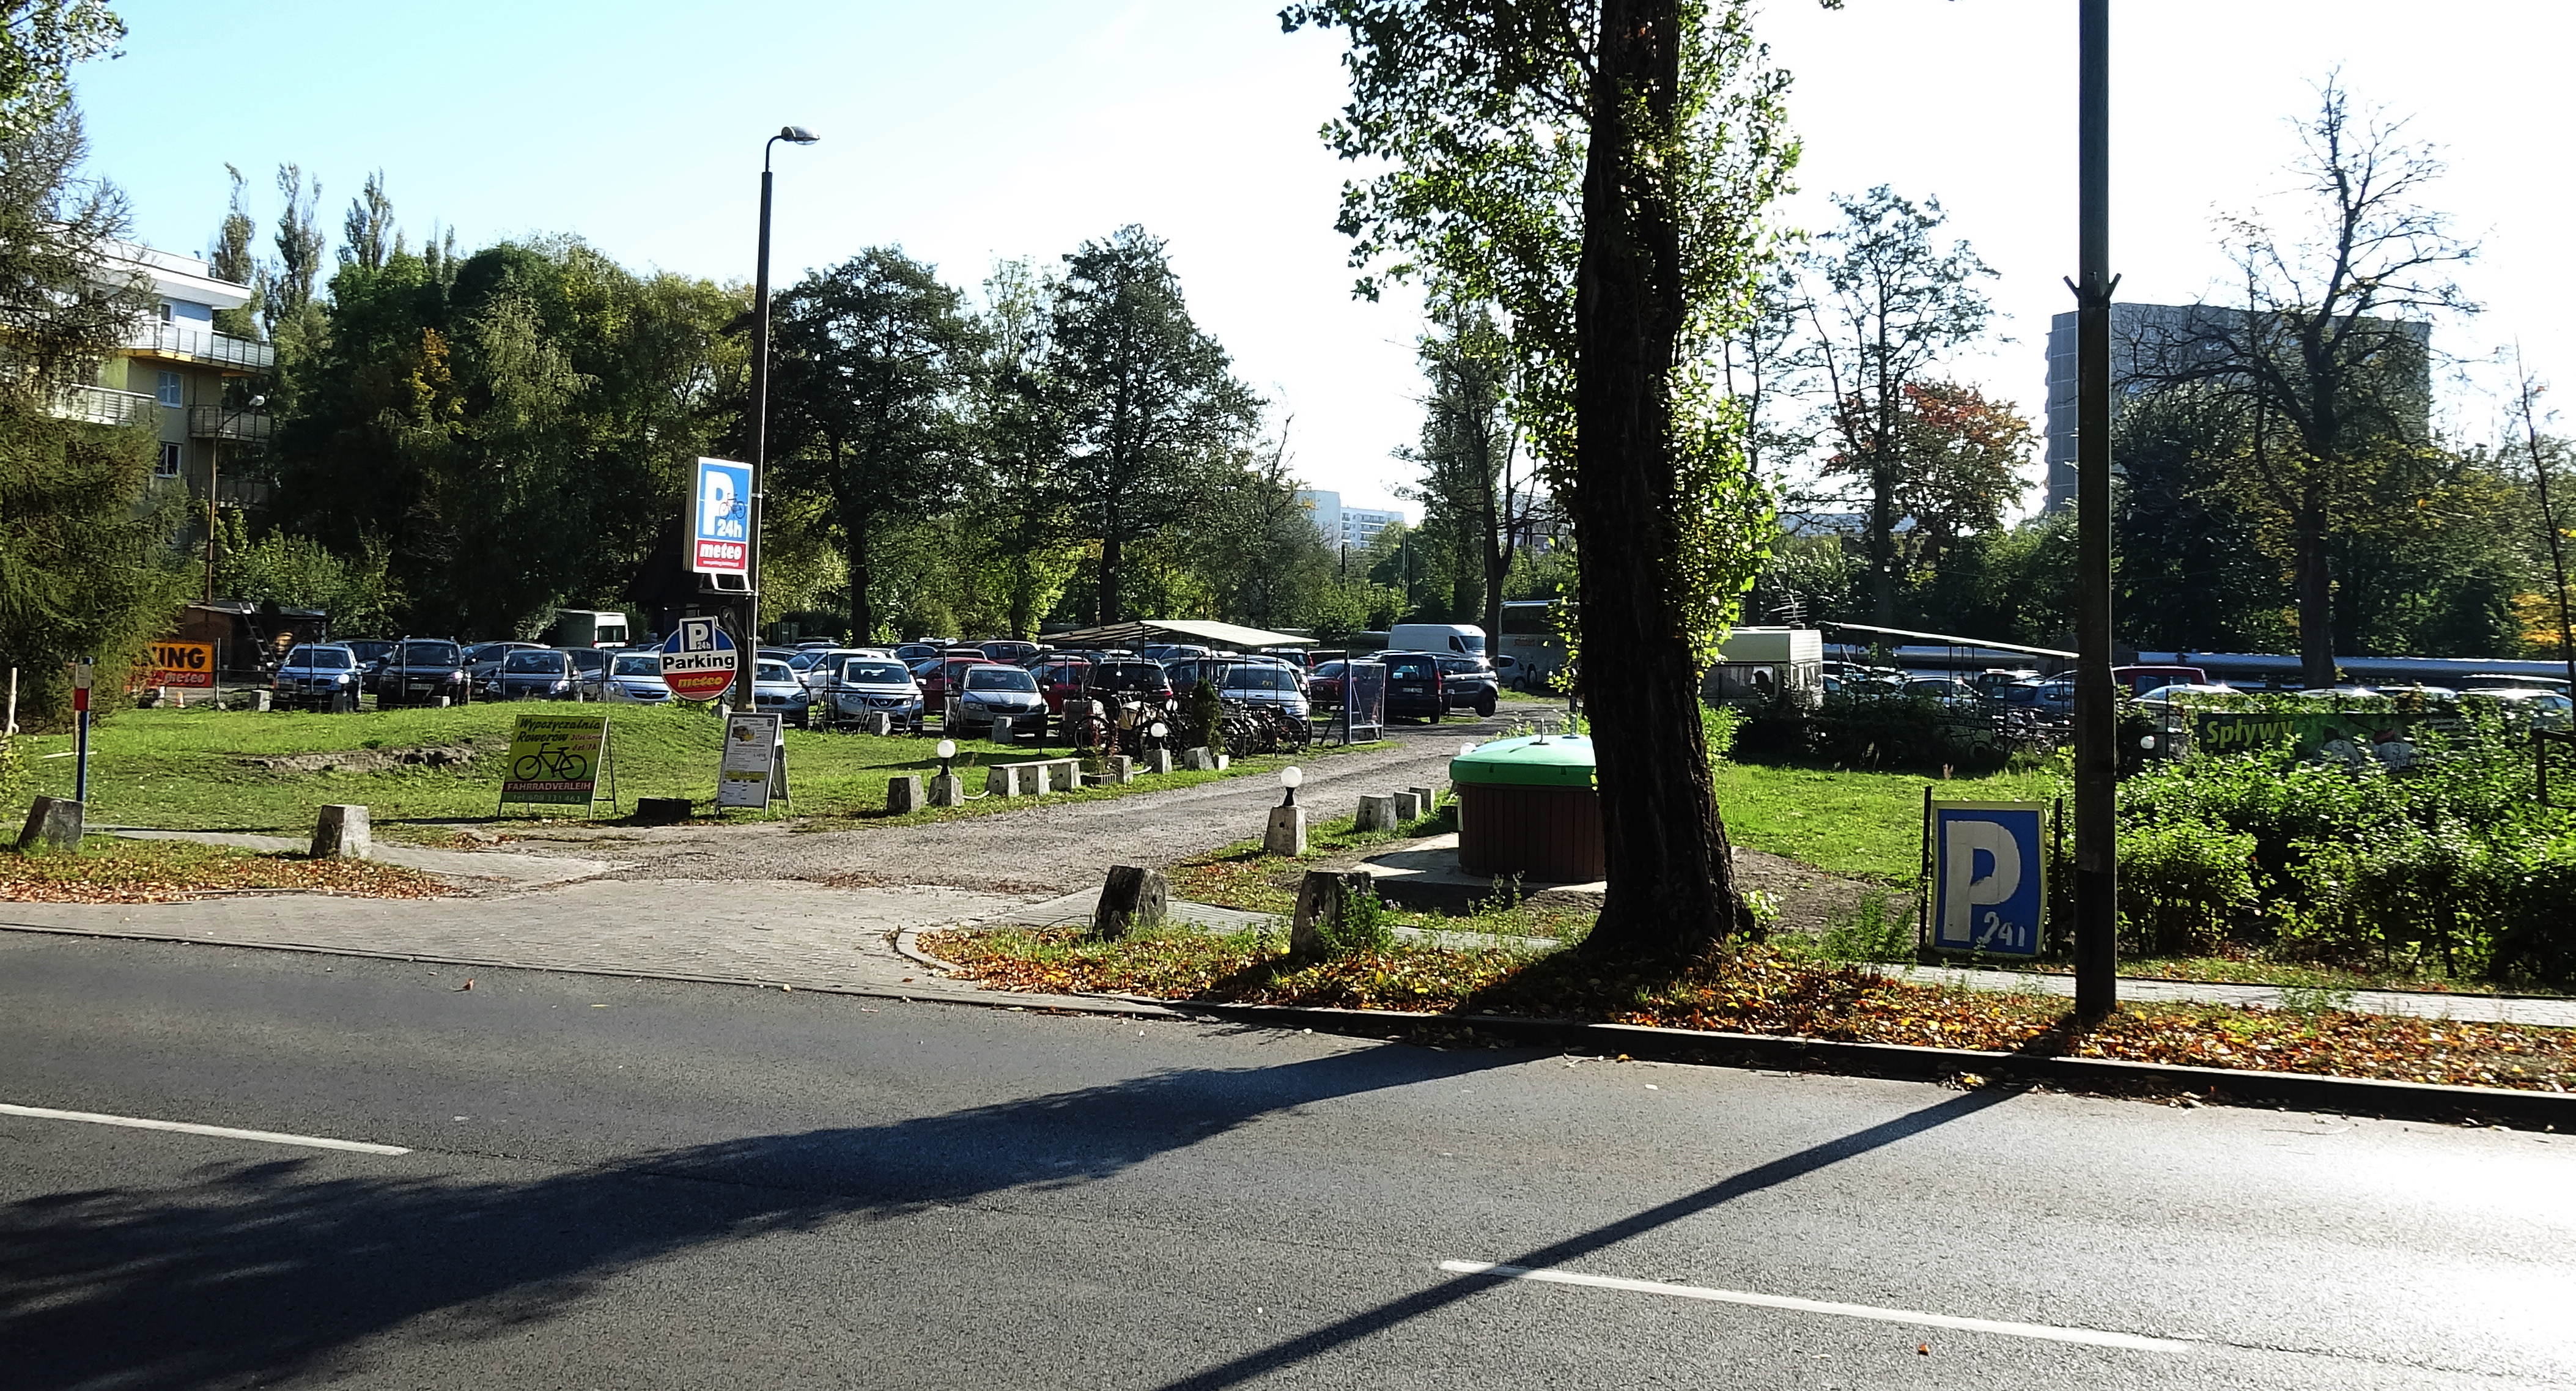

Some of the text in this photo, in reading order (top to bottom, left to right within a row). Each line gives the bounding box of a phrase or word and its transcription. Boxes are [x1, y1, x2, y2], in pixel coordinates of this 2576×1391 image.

[703, 470, 734, 536] P
[717, 519, 742, 538] 24h
[699, 543, 742, 560] meteo
[688, 623, 709, 650] P
[697, 641, 711, 650] 24h
[662, 654, 735, 670] Parking
[678, 676, 724, 688] meteo
[2206, 718, 2295, 748] Spływy
[507, 782, 591, 791] FAHRRADVERLEIH
[1943, 820, 2021, 942] P
